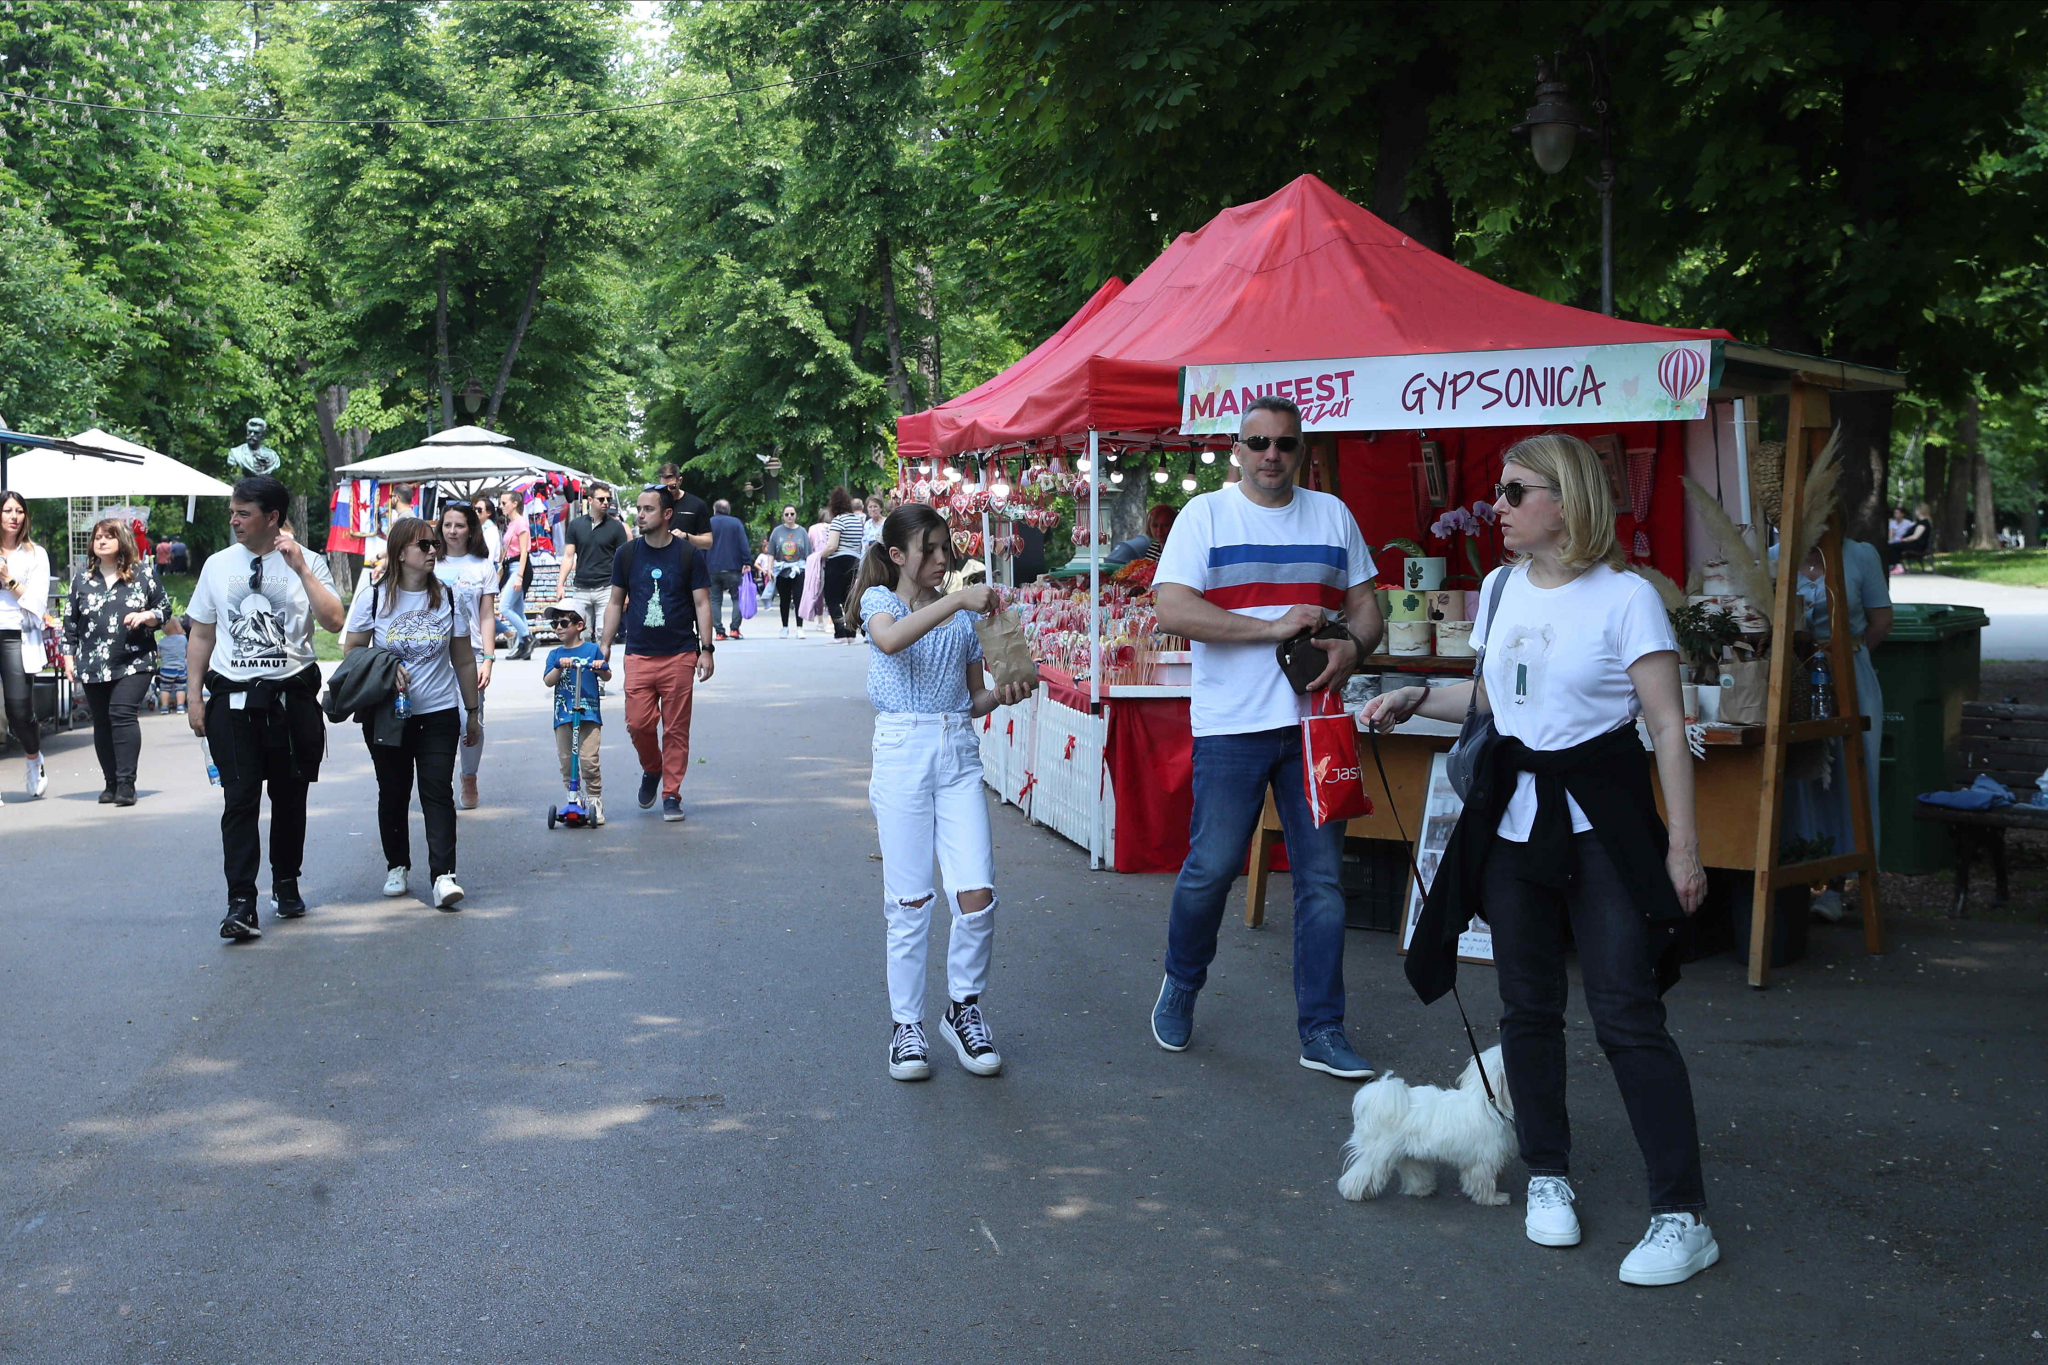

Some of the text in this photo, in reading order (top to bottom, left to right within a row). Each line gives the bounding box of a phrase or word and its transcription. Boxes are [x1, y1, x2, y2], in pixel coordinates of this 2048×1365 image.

[1401, 364, 1606, 415] GYPSONICA
[1293, 396, 1354, 425] azar
[228, 575, 289, 584] COUAYEUR
[231, 659, 288, 668] MAMMUT
